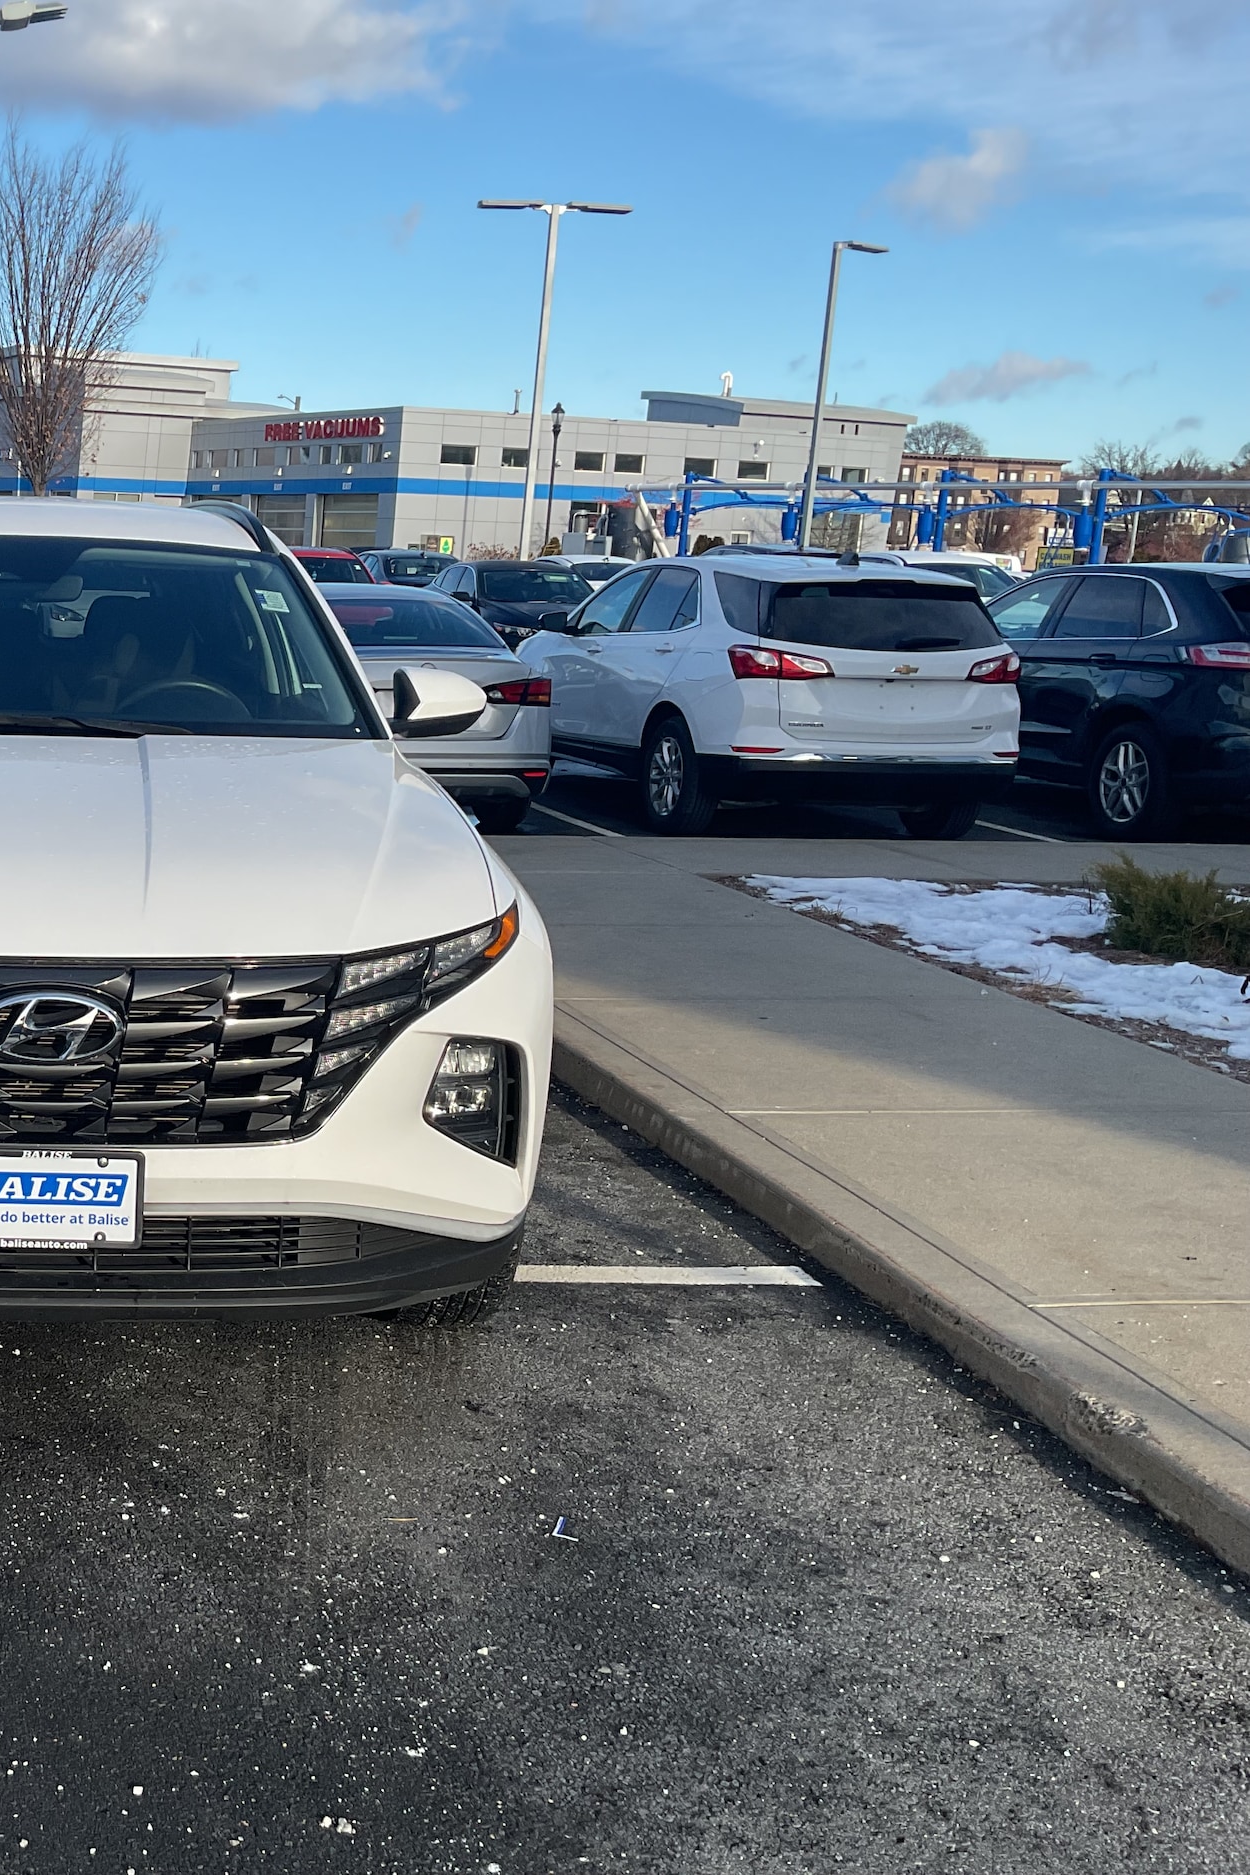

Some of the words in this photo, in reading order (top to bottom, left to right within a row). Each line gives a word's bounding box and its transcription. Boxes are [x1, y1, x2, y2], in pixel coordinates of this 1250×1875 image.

[264, 421, 304, 441] FREE
[305, 416, 384, 439] VACUUMS
[22, 1151, 72, 1159] BALISE
[0, 1210, 18, 1223] do
[22, 1212, 66, 1224] better
[70, 1214, 84, 1224] at
[88, 1213, 129, 1226] Balise
[0, 1238, 88, 1250] baliseauto.com
